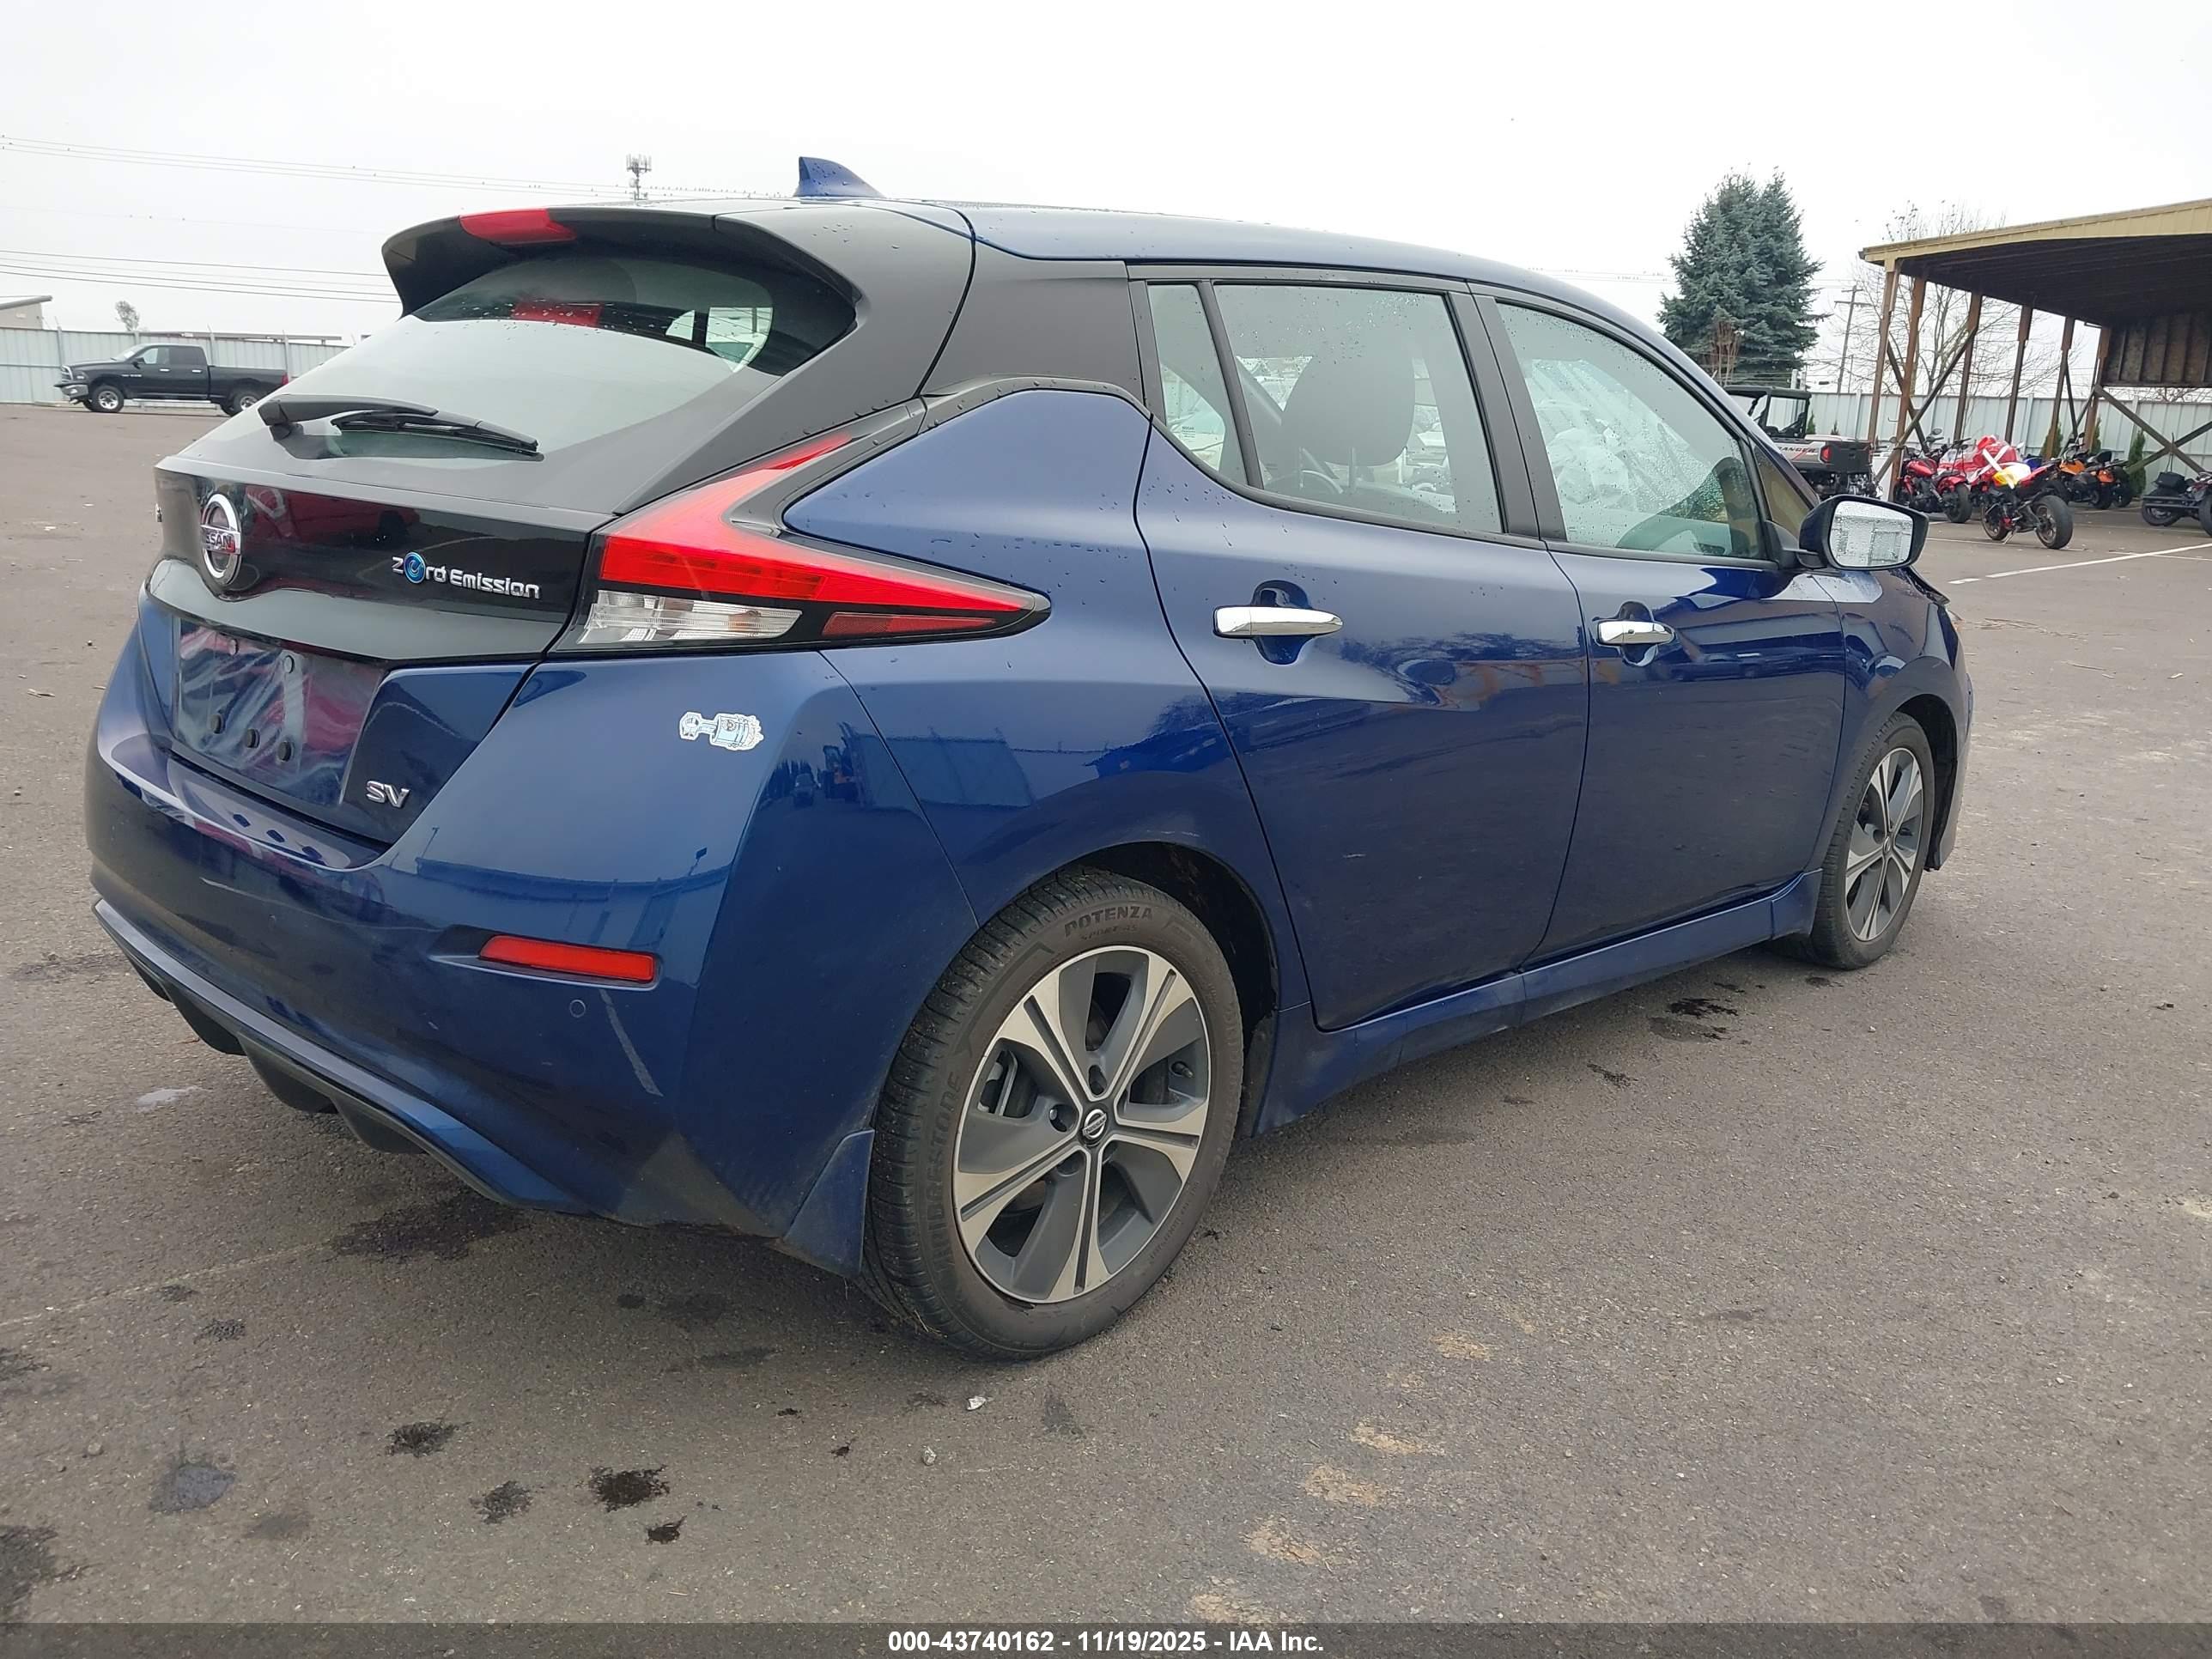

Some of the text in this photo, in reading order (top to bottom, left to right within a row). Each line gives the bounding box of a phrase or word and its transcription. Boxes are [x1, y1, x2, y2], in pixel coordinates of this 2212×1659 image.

[449, 568, 540, 599] Emission
[366, 780, 410, 808] SV
[1064, 906, 1153, 938] POTENZA
